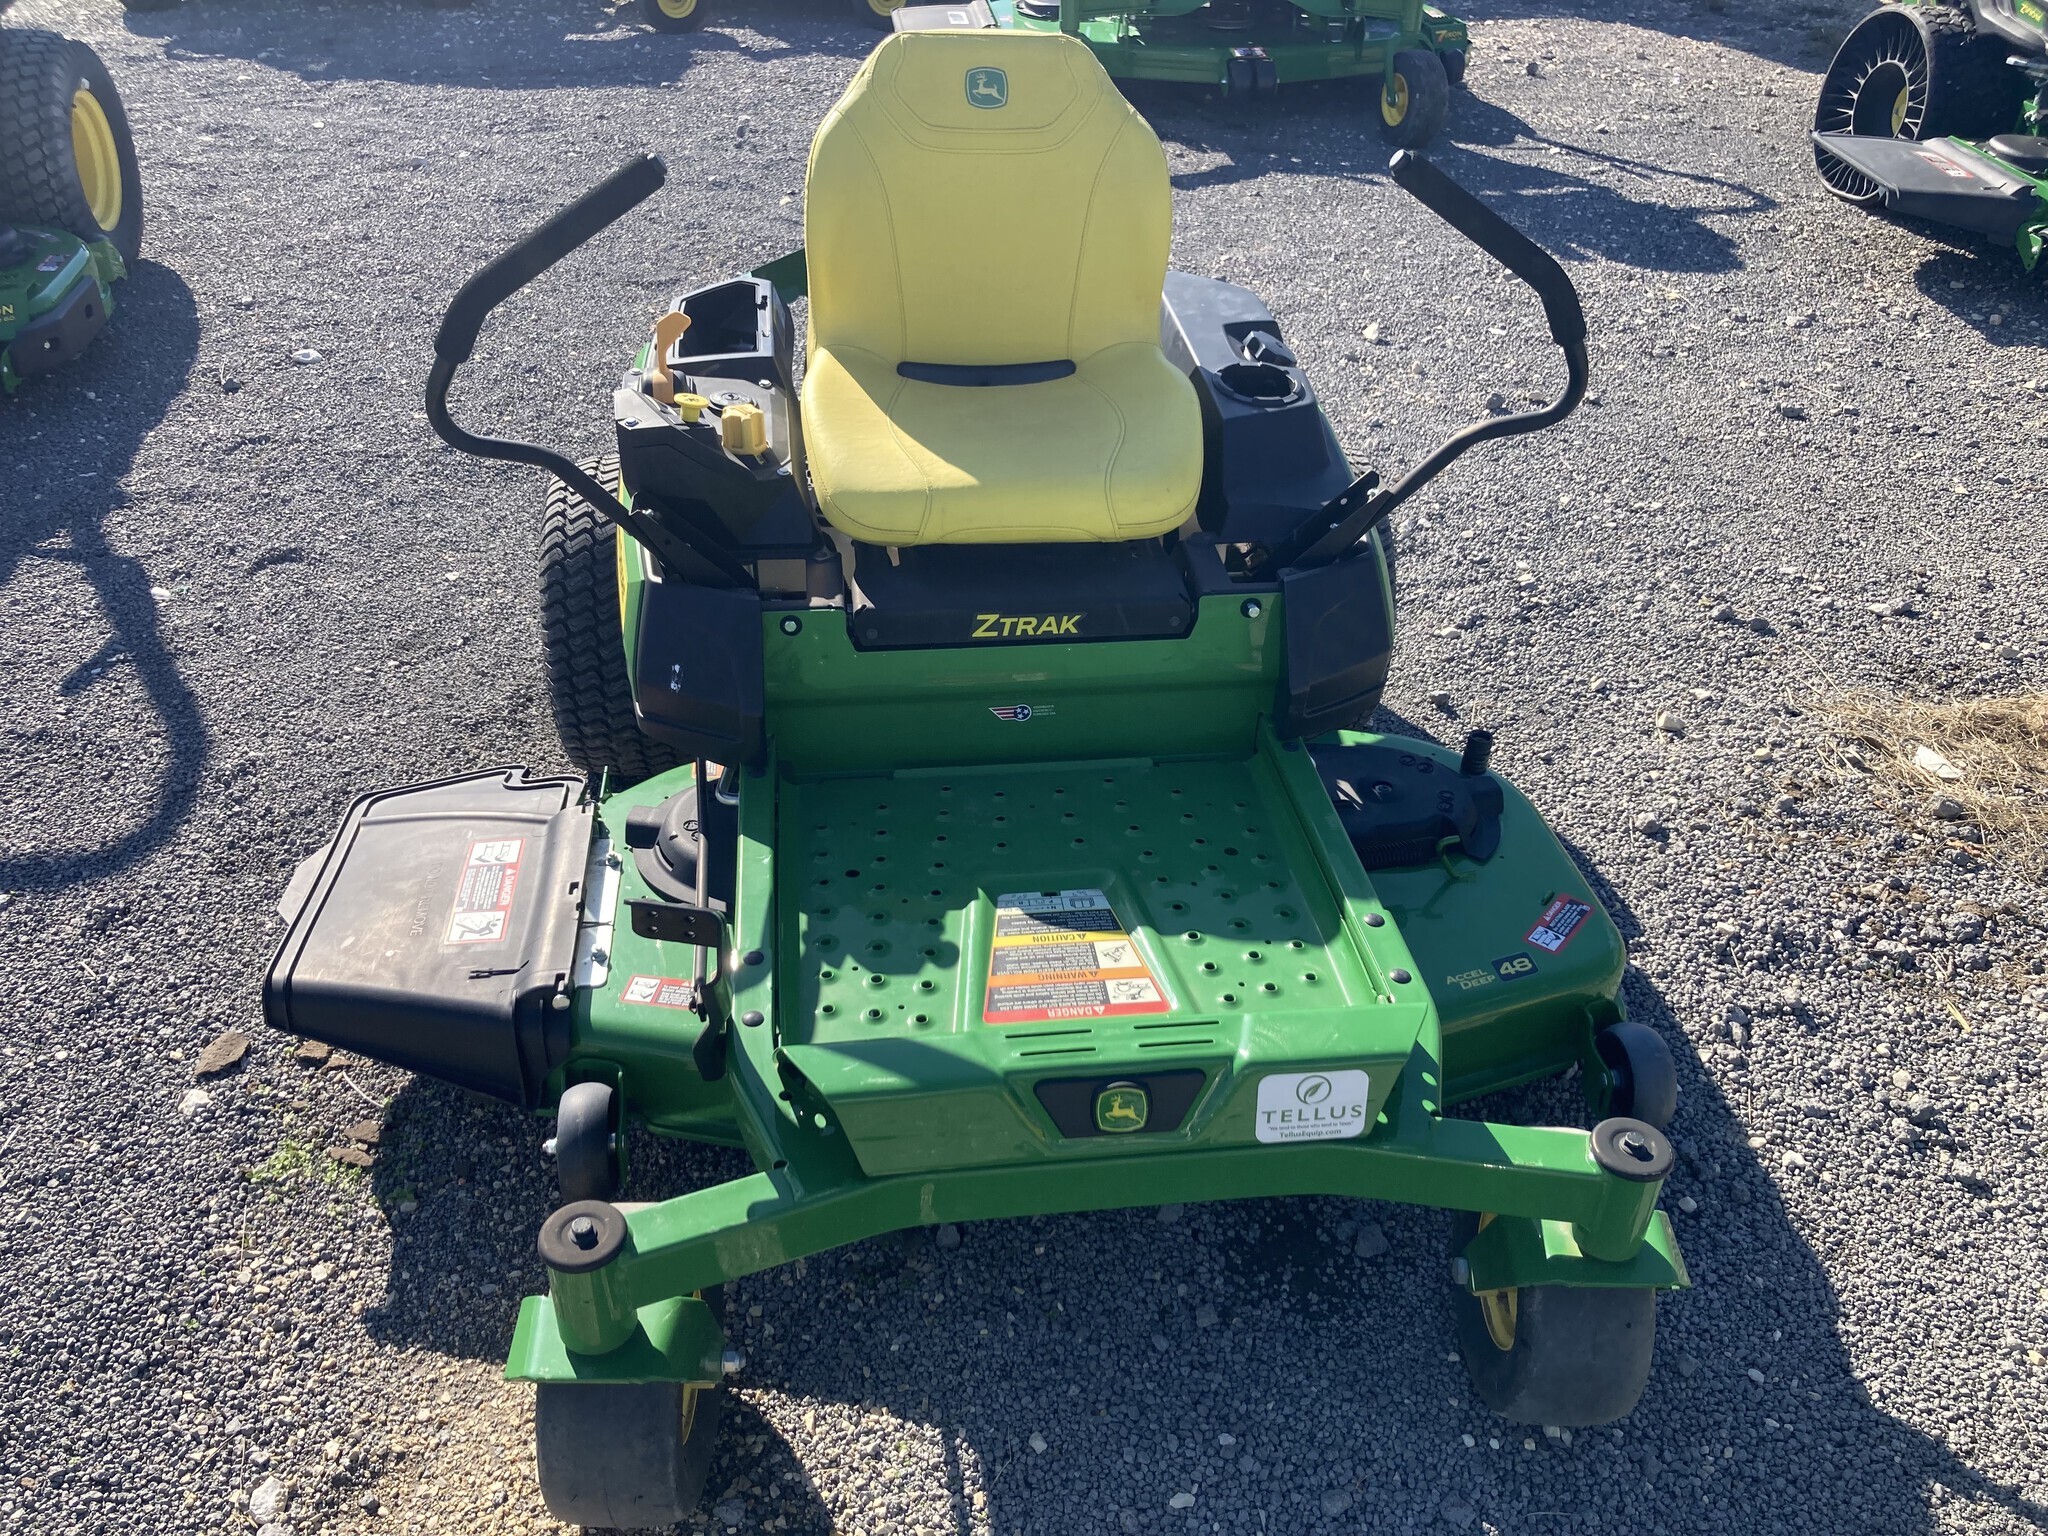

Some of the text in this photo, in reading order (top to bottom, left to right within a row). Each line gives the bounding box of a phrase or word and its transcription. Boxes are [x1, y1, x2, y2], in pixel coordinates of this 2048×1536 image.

[972, 613, 1082, 637] ZTRAK
[500, 875, 515, 907] DANGER
[1545, 901, 1562, 916] DANGER
[1032, 933, 1075, 942] CAUTION
[1499, 957, 1533, 975] 48
[1037, 970, 1087, 981] WARNING
[1446, 968, 1488, 985] ACCEL
[1459, 974, 1496, 990] DEEP
[1047, 1006, 1093, 1017] DANGER
[1261, 1104, 1363, 1124] TELLUS
[1280, 1129, 1342, 1139] TellusEquip.com
